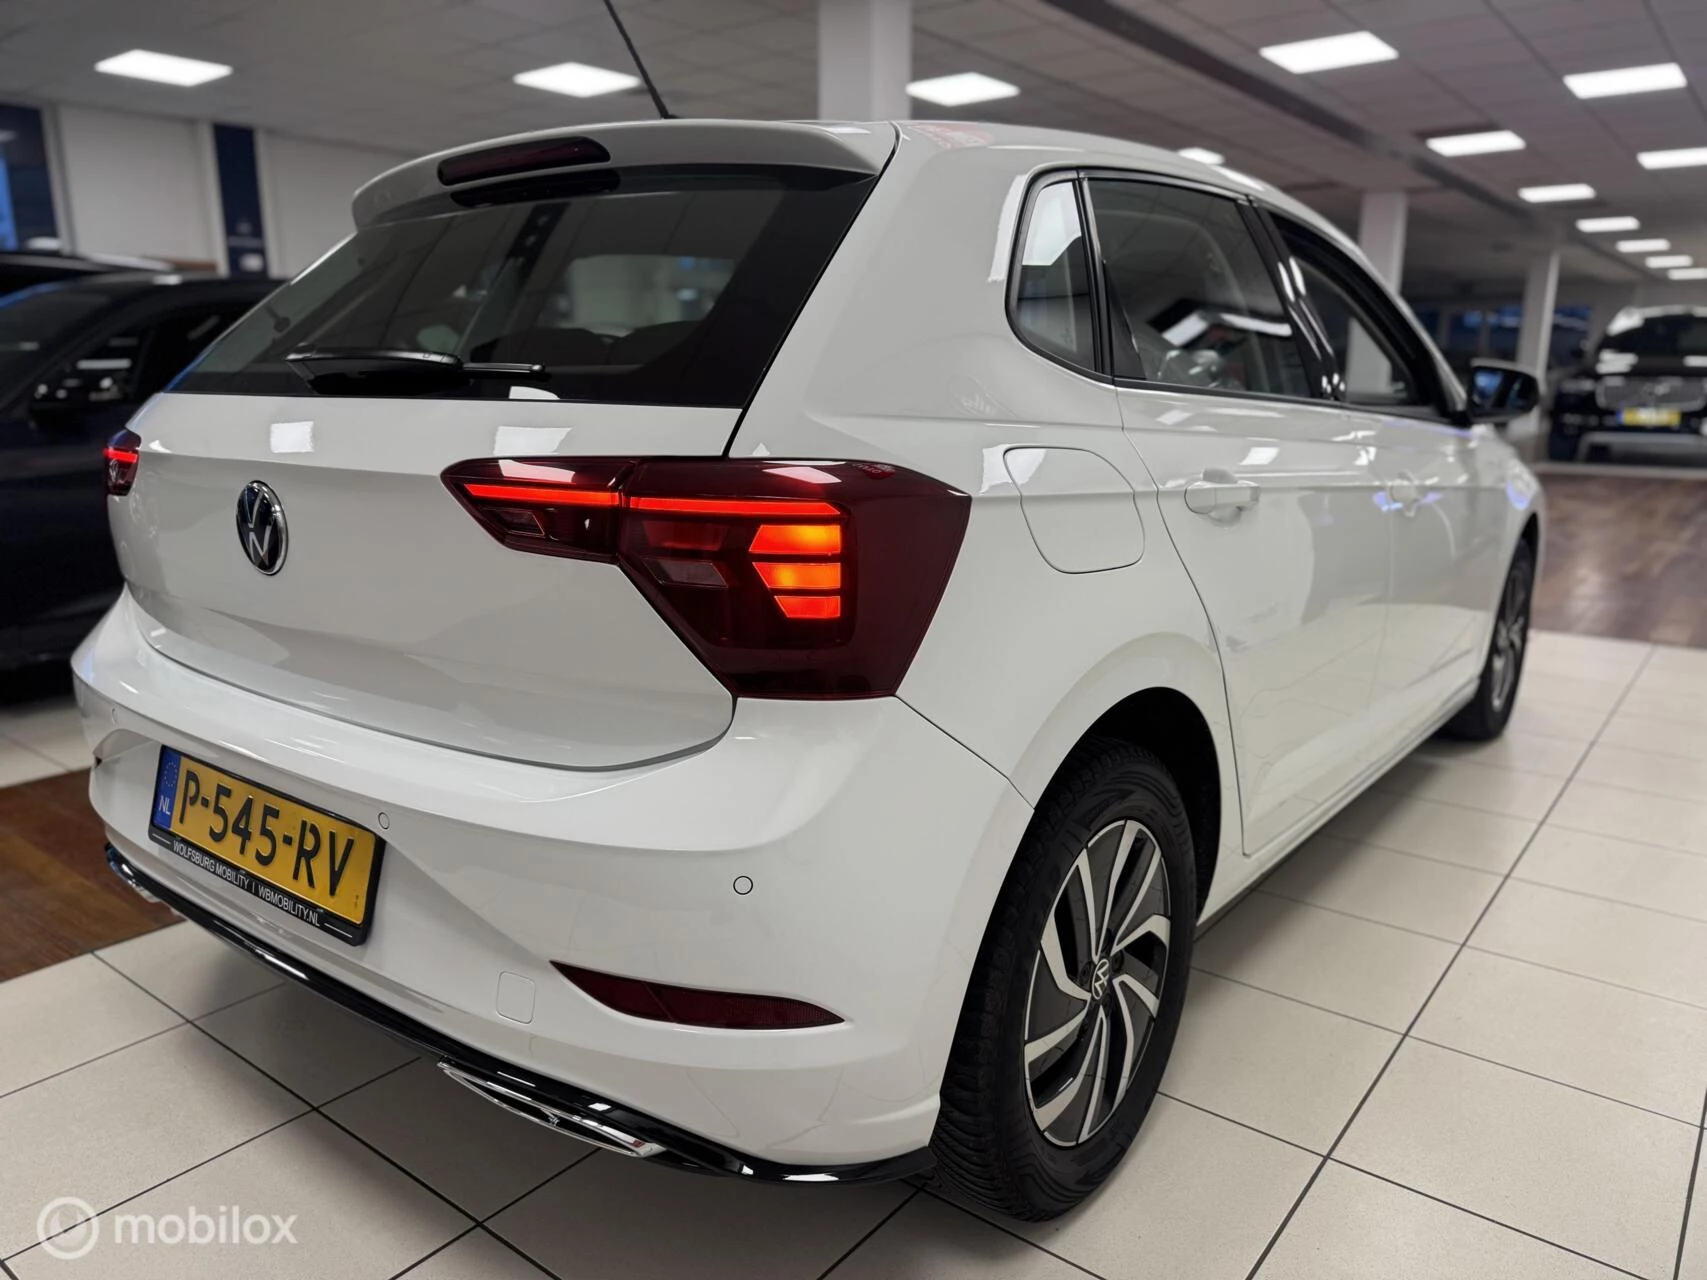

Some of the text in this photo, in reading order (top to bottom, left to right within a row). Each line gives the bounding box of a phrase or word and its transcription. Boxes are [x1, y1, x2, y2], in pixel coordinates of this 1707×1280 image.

[159, 797, 171, 816] NL
[179, 770, 354, 897] P-545-RV
[173, 841, 216, 873] WOLFSBURG
[215, 864, 250, 890] MOBILITY
[259, 885, 321, 927] WBMOBILITY.NL
